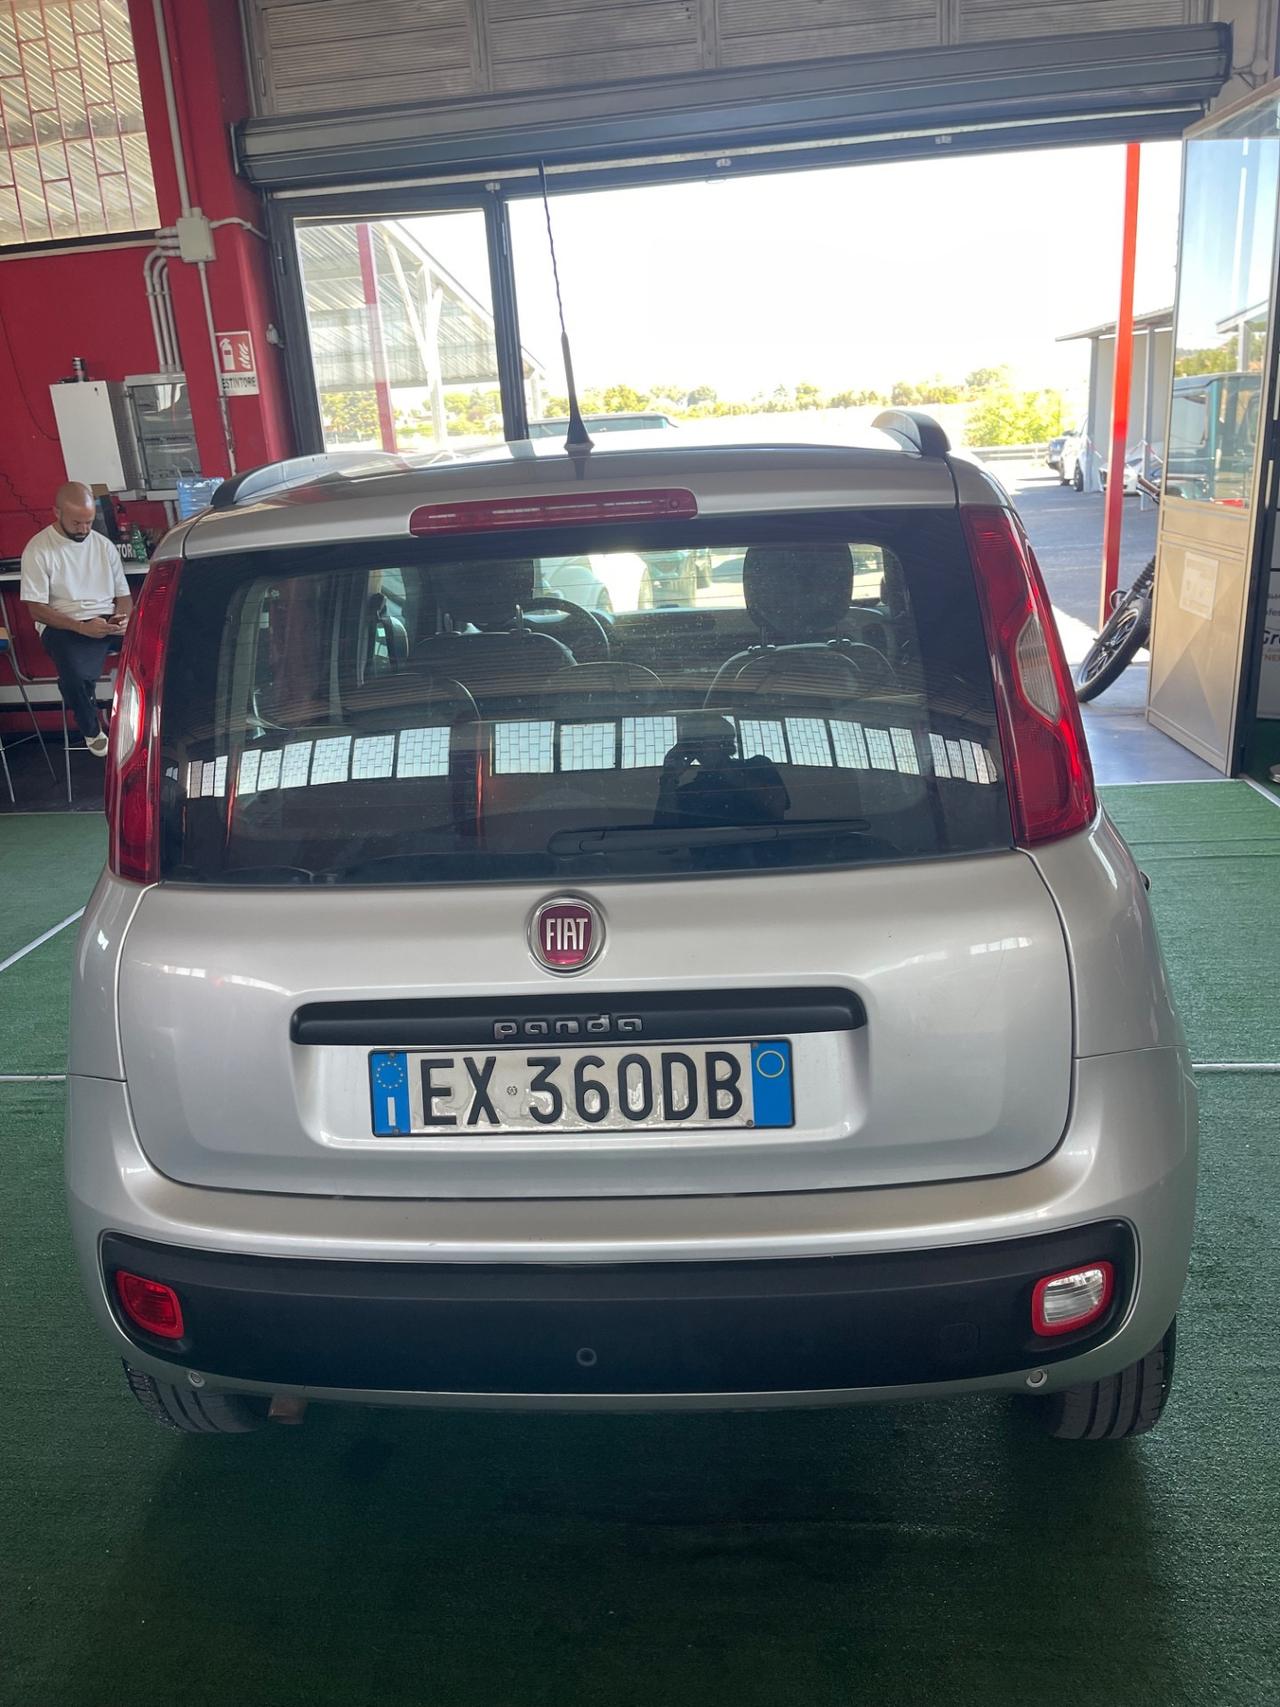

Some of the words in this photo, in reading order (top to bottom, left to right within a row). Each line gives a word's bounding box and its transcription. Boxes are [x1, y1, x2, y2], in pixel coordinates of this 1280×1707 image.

[221, 376, 256, 390] ESTINTORE
[545, 918, 589, 951] FIAT
[493, 1014, 643, 1040] panda
[420, 1056, 501, 1126] EX
[526, 1051, 743, 1125] 360DB
